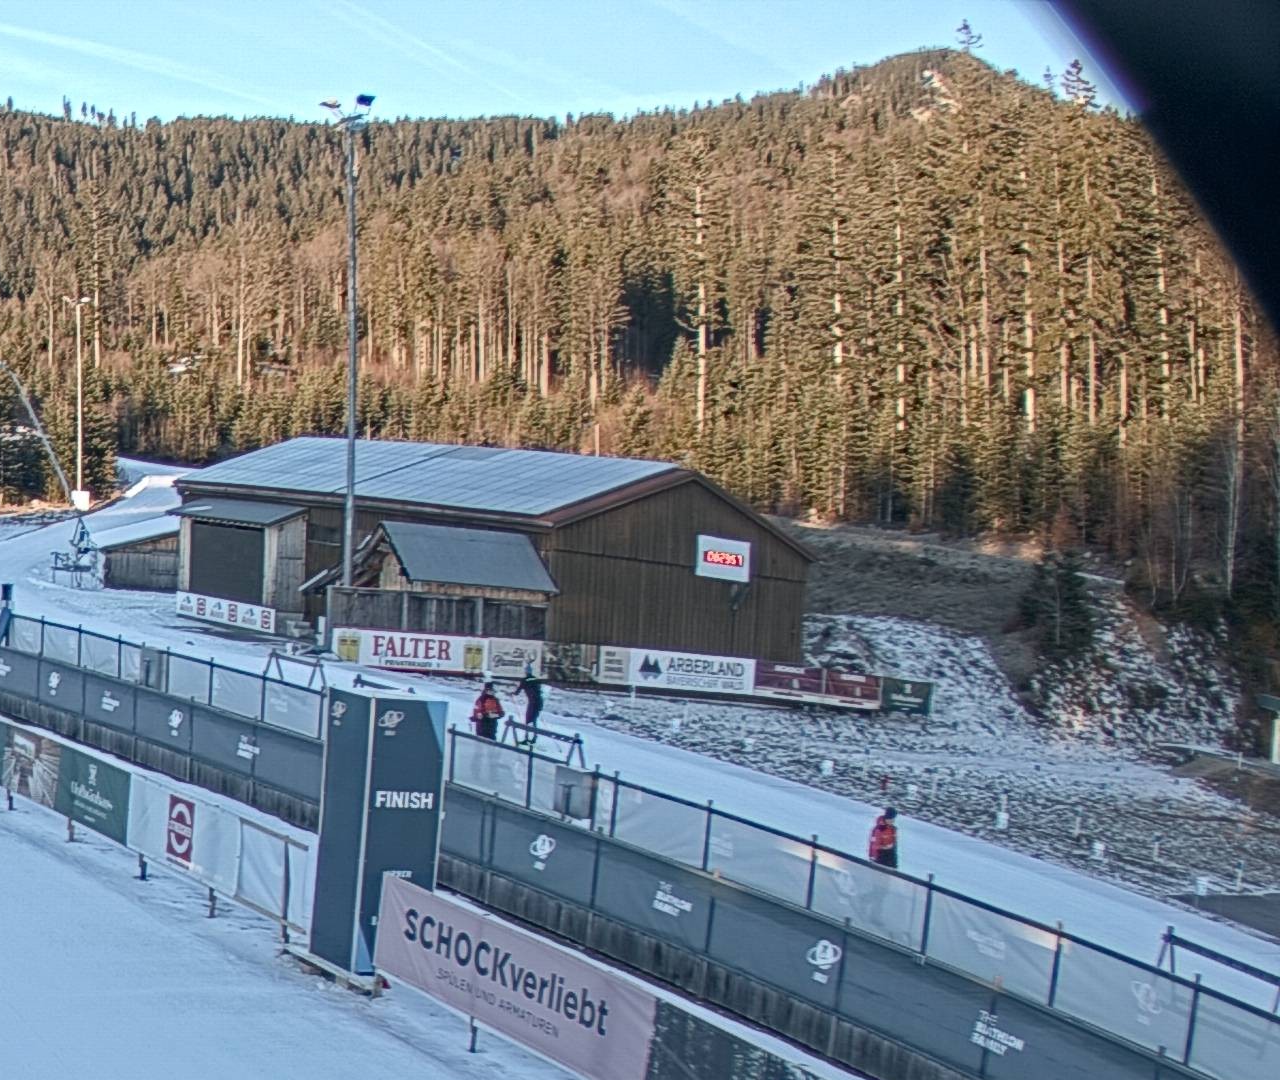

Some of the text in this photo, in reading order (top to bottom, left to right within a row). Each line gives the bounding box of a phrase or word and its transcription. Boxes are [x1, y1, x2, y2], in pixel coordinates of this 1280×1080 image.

[372, 634, 451, 661] FALTER
[666, 657, 745, 678] ARBERLAND
[375, 790, 434, 809] FINISH
[403, 908, 609, 1036] SCHOCKverliebt
